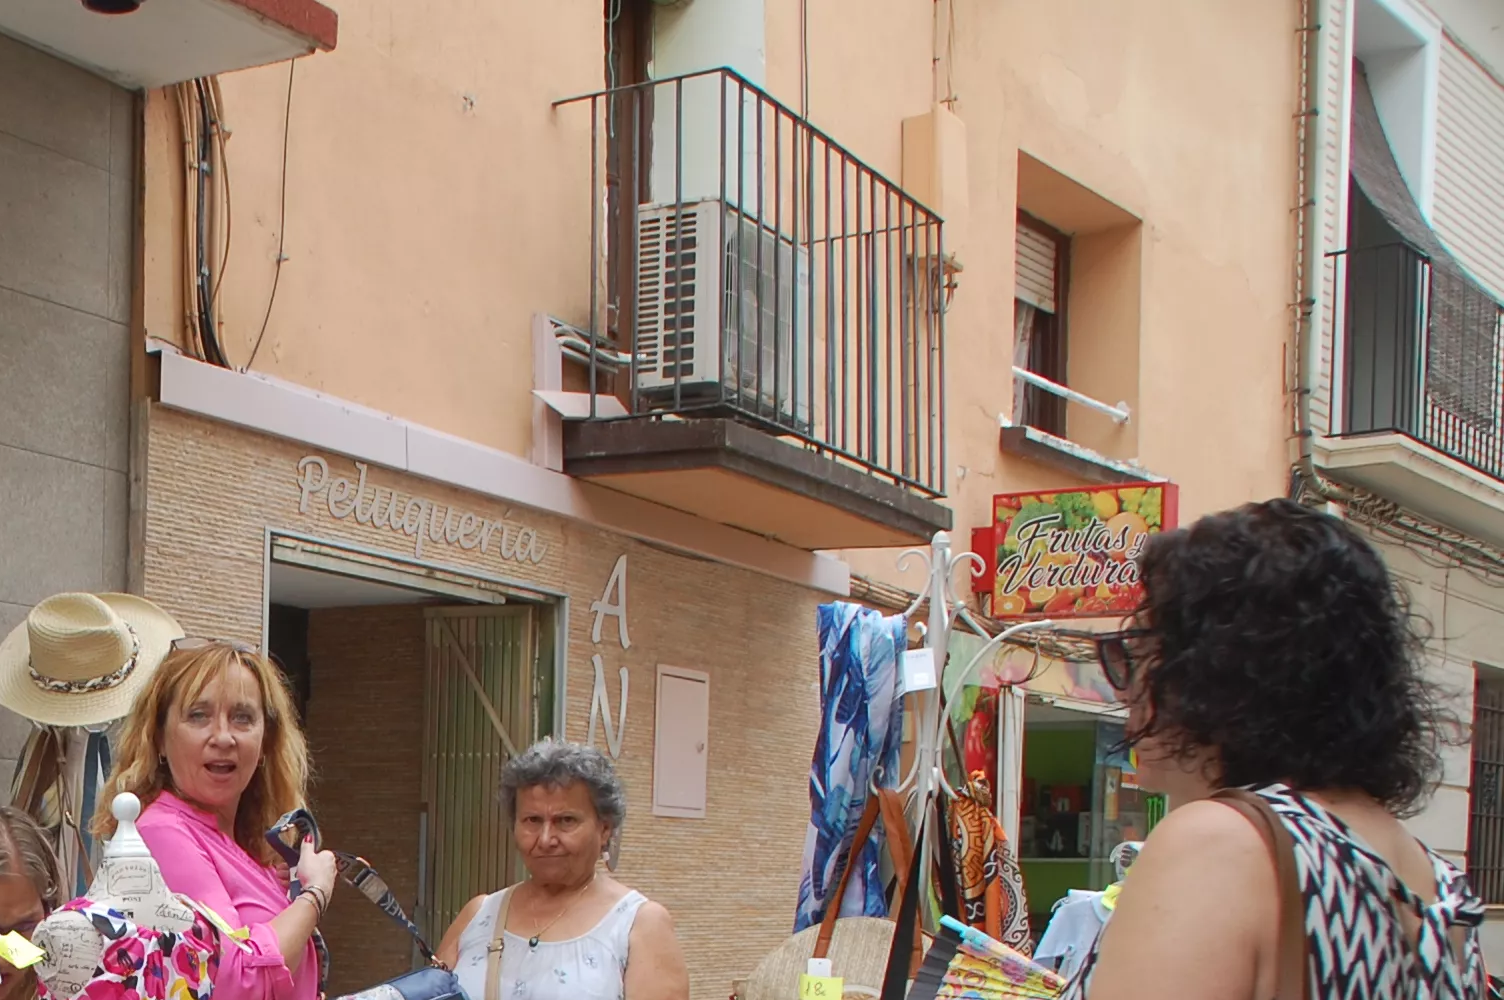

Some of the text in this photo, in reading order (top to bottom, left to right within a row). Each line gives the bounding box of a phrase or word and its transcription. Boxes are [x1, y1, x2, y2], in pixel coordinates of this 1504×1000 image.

[296, 454, 548, 565] Peluquería
[1016, 513, 1148, 561] Frutas y
[998, 551, 1142, 595] Verdura
